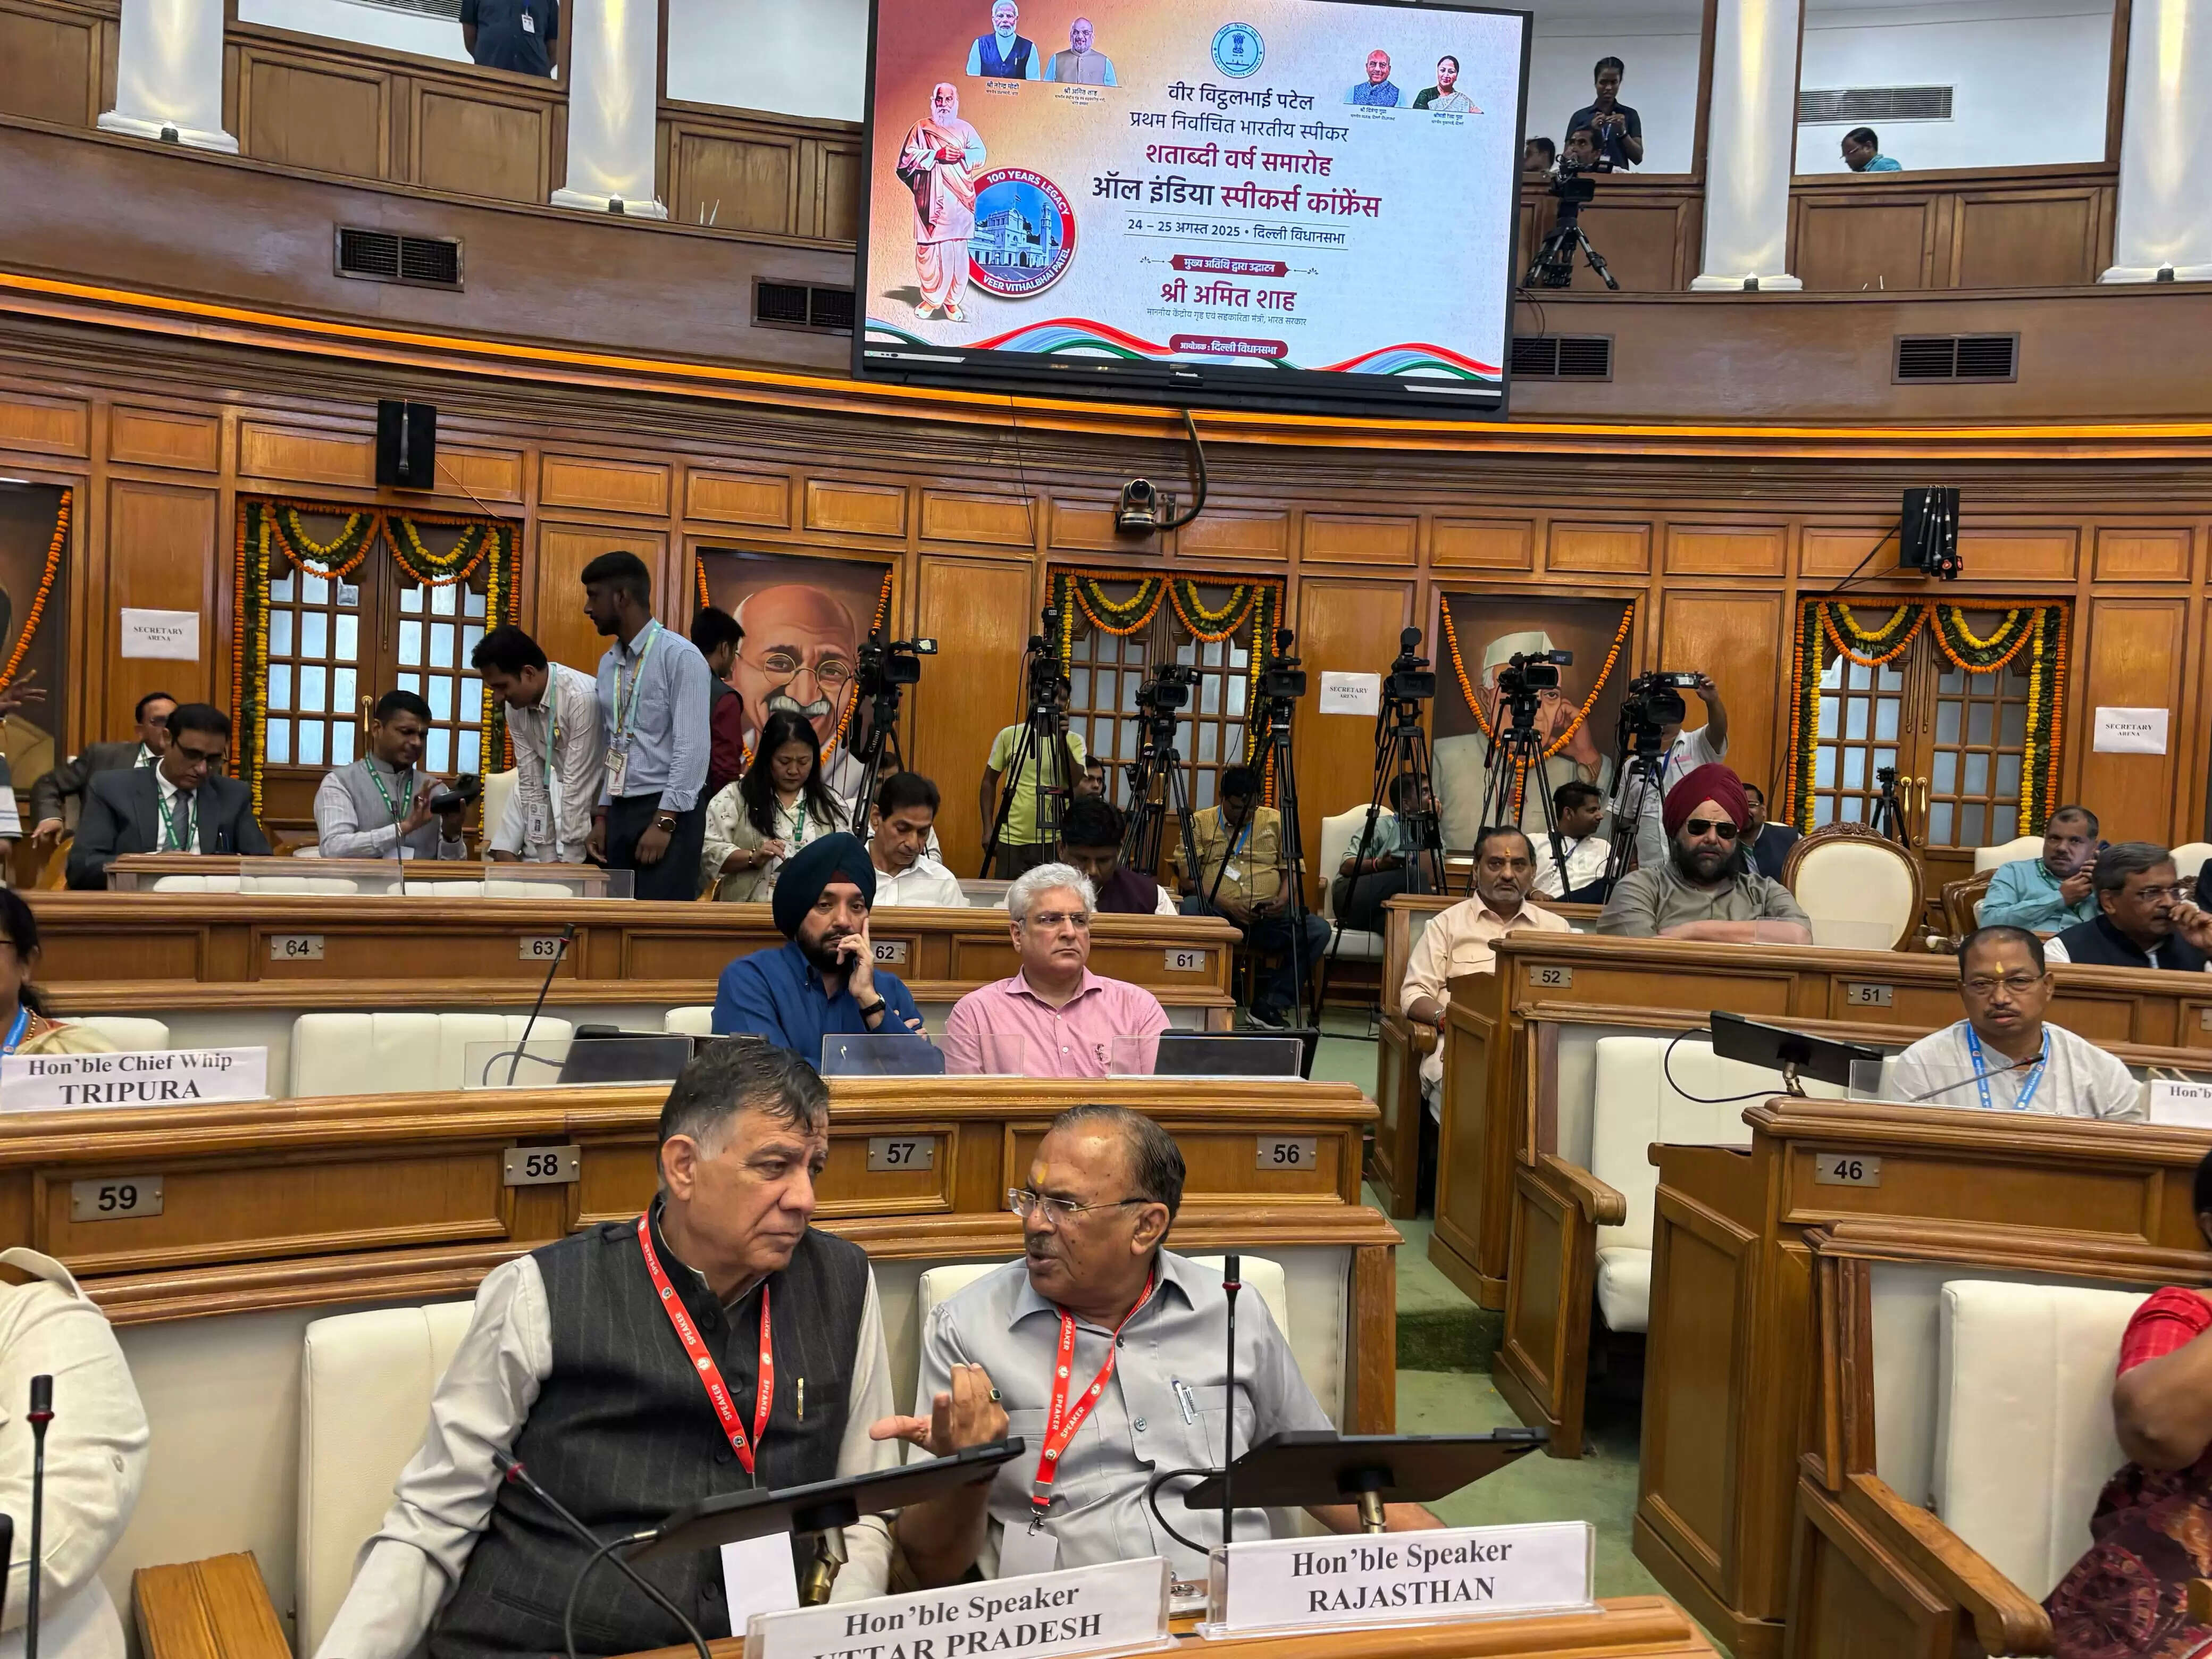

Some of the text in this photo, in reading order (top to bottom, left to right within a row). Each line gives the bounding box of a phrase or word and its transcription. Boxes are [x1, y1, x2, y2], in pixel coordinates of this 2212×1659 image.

[1168, 82, 1314, 111] वीर विट्ठलभाई पटेल
[1130, 111, 1350, 143] प्रथम निर्वाचित भारतीय स्पीकर
[1145, 142, 1333, 177] शताब्दी वर्ष समारोह
[987, 171, 1070, 215] 100 YEARS LEGACY
[1092, 171, 1382, 217] ऑल इंडिया स्पीकर्स कांफ्रेंस
[1128, 219, 1143, 230] 24
[1158, 221, 1171, 232] 25
[1176, 222, 1208, 236] अगस्त
[1211, 225, 1240, 237] 2025
[1253, 224, 1287, 241] दिल्ली
[1291, 228, 1345, 245] विधानसभा
[983, 248, 1070, 291] VEER VITHALBHAI PATEL
[1184, 258, 1203, 270] मुख्य
[1204, 258, 1230, 270] अतिथि
[1160, 277, 1297, 311] श्री अमित शाह
[1146, 307, 1171, 316] माननीय
[1211, 340, 1236, 352] दिल्ली
[1238, 343, 1277, 355] विधानसभा
[133, 626, 183, 635] SECRETARY
[286, 940, 309, 957] 64
[533, 941, 555, 956] 63
[875, 945, 894, 960] 62
[1177, 954, 1194, 968] 61
[1541, 970, 1561, 984] 52
[1862, 988, 1880, 1002] 51
[119, 1054, 174, 1071] Chief
[180, 1053, 232, 1071] Whip
[59, 1079, 202, 1105] TRIPURA
[525, 1154, 558, 1177] 58
[886, 1143, 915, 1164] 57
[1272, 1144, 1300, 1163] 56
[1833, 1161, 1863, 1179] 46
[97, 1185, 138, 1211] 59
[643, 1243, 659, 1275] SPEAKER
[675, 1311, 697, 1346] SPEAKER
[1063, 1316, 1071, 1351] SPEAKER
[711, 1384, 732, 1421] SPEAKER
[759, 1379, 770, 1417] SPEAKER
[1052, 1394, 1063, 1430] SPEAKER
[1060, 1406, 1085, 1438] SPEAKER
[1406, 1540, 1513, 1573] Speaker
[968, 1585, 1080, 1623] Speaker
[1307, 1577, 1495, 1612] RAJASTHAN
[813, 1613, 1103, 1659] TAR PRADESH
